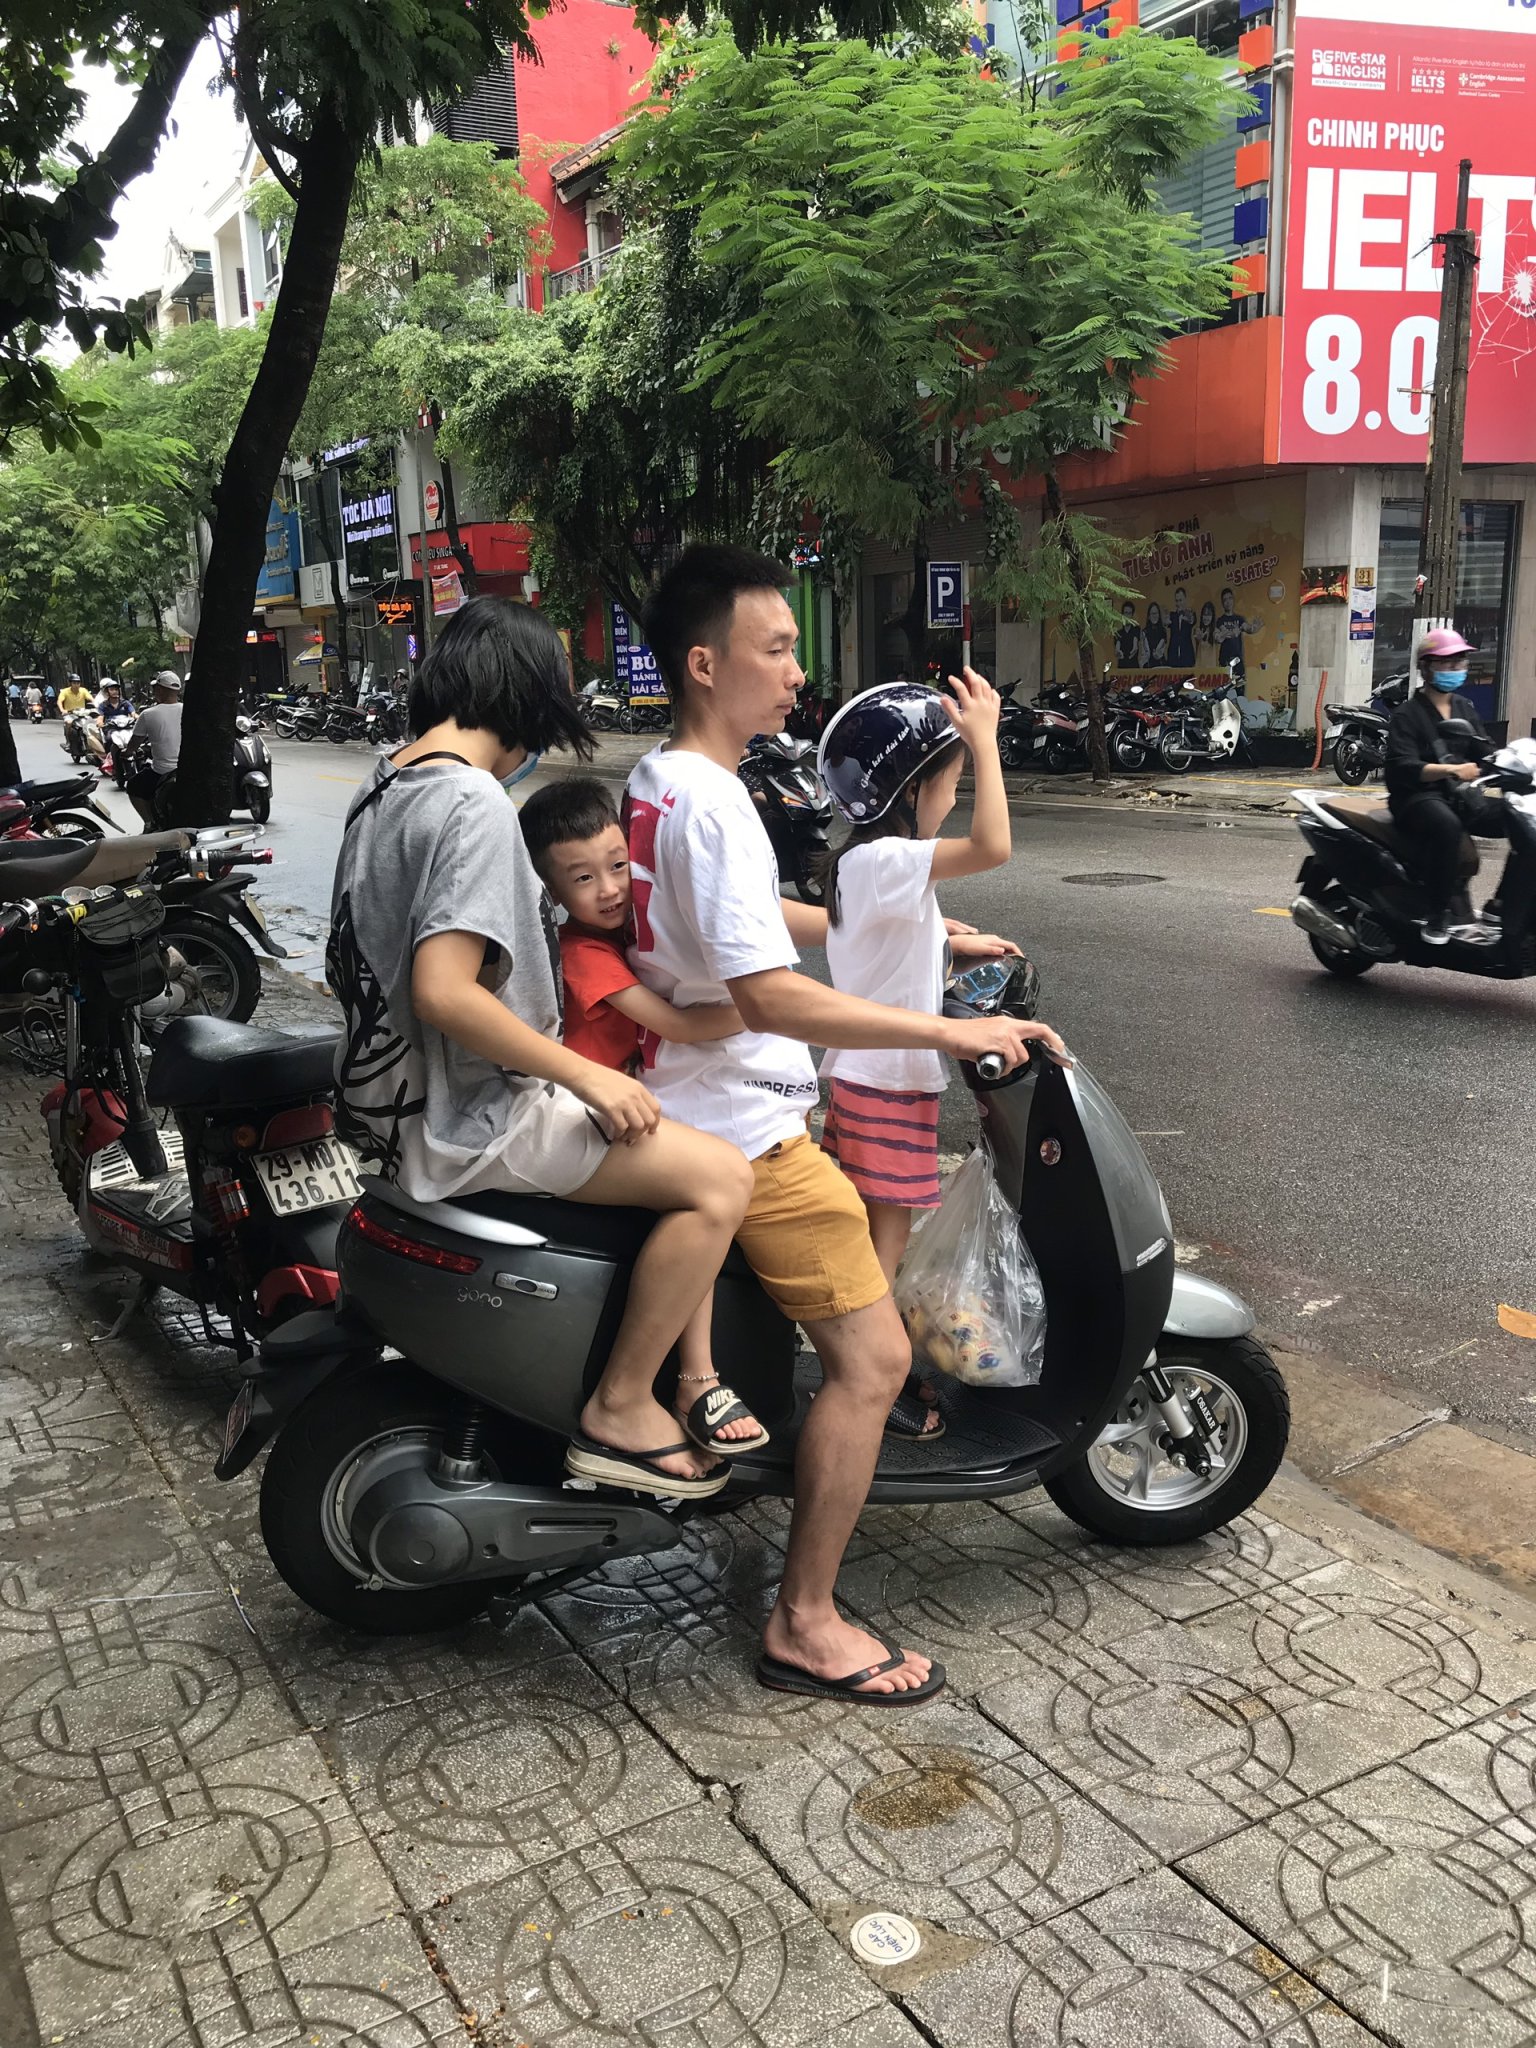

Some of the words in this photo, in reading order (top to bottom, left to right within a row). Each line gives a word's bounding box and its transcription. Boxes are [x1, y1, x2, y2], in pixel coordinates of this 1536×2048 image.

[1334, 51, 1386, 65] FIVE-STAR
[1334, 63, 1386, 79] ENGLISH
[1469, 72, 1496, 81] Cambridge
[1497, 74, 1525, 82] Assessment
[1411, 75, 1445, 88] IELTS
[1469, 80, 1486, 88] English
[1307, 117, 1378, 149] CHINH
[1384, 123, 1444, 157] PHỤC
[1302, 166, 1536, 293] IELT
[342, 499, 360, 526] TÓC
[361, 493, 375, 521] HÀ
[375, 489, 392, 522] NỘI
[1178, 513, 1200, 533] PHÁ
[1176, 532, 1214, 565] ANH
[1359, 569, 1371, 580] 31
[937, 576, 955, 608] P
[631, 651, 657, 671] BÚ
[632, 671, 657, 681] BÁNH
[631, 682, 649, 694] HẢI
[651, 682, 667, 694] SẢ
[274, 1167, 361, 1210] 436.11
[706, 1389, 736, 1413] NIKE
[1196, 1396, 1216, 1430] OSAKAR
